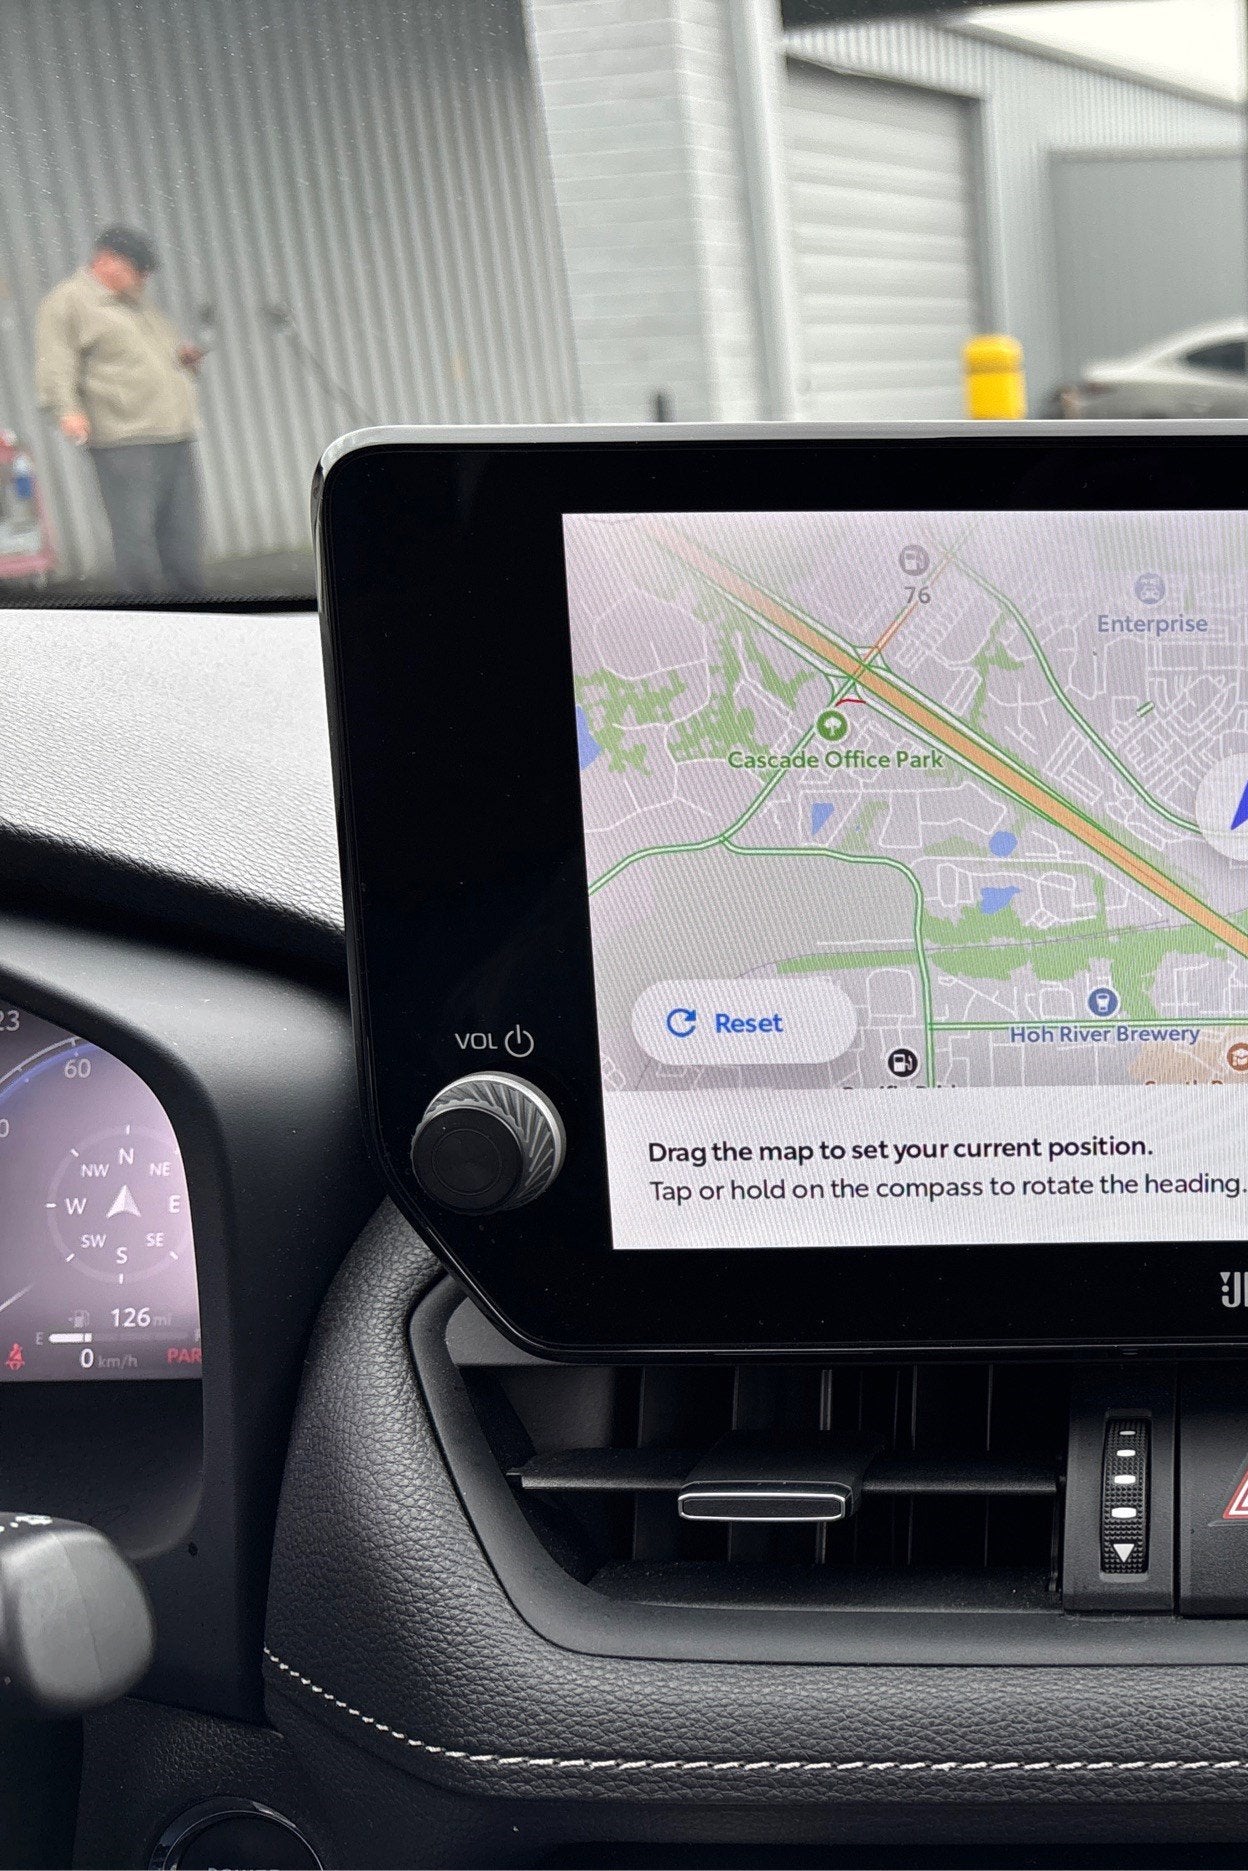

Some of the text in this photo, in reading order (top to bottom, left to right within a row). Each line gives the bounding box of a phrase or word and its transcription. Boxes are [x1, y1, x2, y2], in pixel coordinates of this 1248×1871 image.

[903, 585, 931, 605] 76
[1097, 614, 1208, 636] Enterprise
[727, 749, 943, 770] Cascade Office Park
[715, 1013, 783, 1034] Reset
[455, 1033, 498, 1049] VOL
[1010, 1025, 1200, 1047] Hoh River Brewery
[64, 1058, 91, 1078] 60
[119, 1149, 133, 1164] N
[648, 1136, 1153, 1167] Drag the map to set your current position.
[81, 1165, 109, 1178] NW
[150, 1163, 171, 1176] NE
[650, 1172, 1247, 1205] Tap or hold on the compass to rotate the heading.
[66, 1199, 86, 1214] W
[169, 1196, 180, 1213] E
[81, 1235, 106, 1248] SW
[145, 1233, 164, 1246] SE
[116, 1247, 127, 1264] S
[111, 1308, 151, 1327] 126
[80, 1349, 137, 1368] 0 km/h
